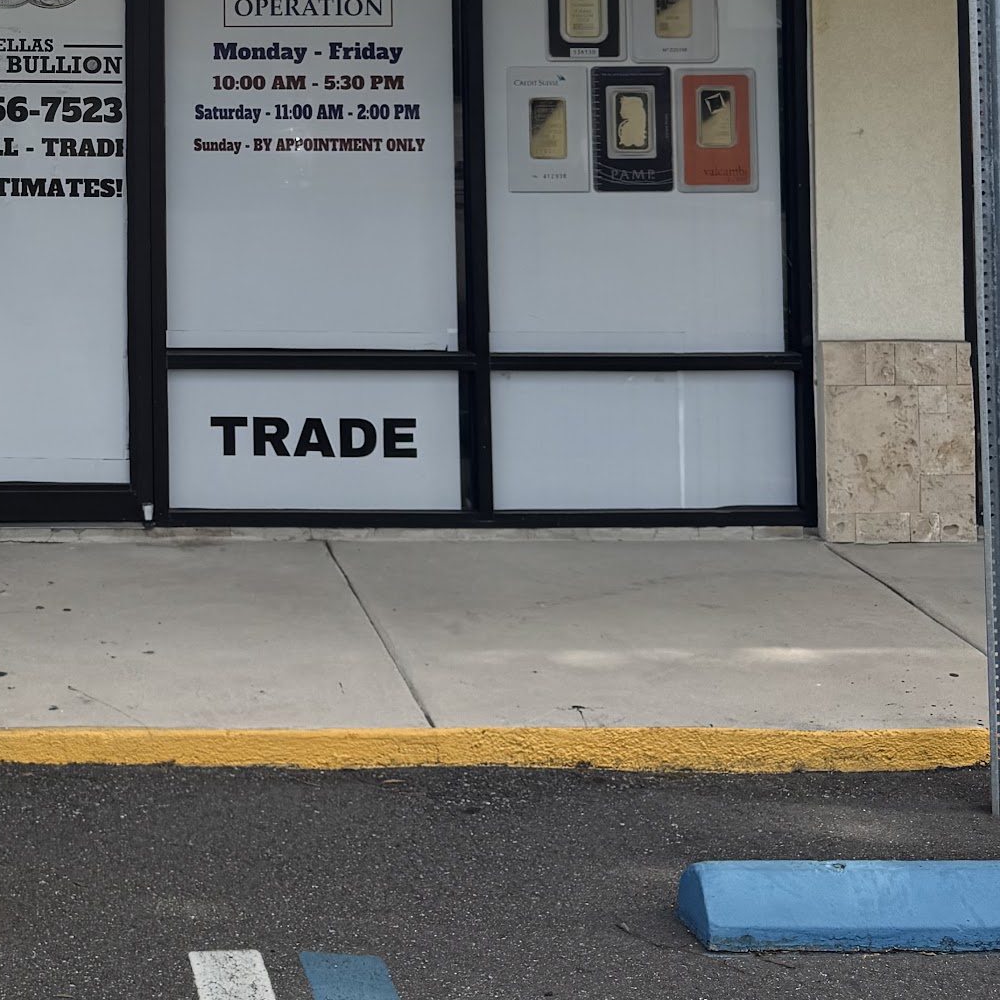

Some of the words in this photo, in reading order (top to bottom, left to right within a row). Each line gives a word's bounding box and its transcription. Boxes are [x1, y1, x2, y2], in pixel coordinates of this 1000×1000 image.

[213, 42, 307, 63] Monday
[329, 42, 403, 63] Friday
[7, 56, 122, 74] BULLION
[213, 75, 265, 90] 10:00
[271, 75, 306, 90] AM
[324, 75, 364, 90] 5:30
[370, 75, 404, 90] PM
[195, 105, 261, 123] Saturday
[274, 104, 312, 119] 11:00
[317, 104, 343, 119] AM
[357, 104, 389, 119] 2:00
[394, 104, 420, 119] PM
[194, 139, 242, 154] Sunday
[254, 139, 270, 151] BY
[275, 139, 382, 151] APPOINTMENT
[386, 139, 425, 151] ONLY
[703, 167, 746, 177] valcamb
[211, 417, 417, 458] TRADE
